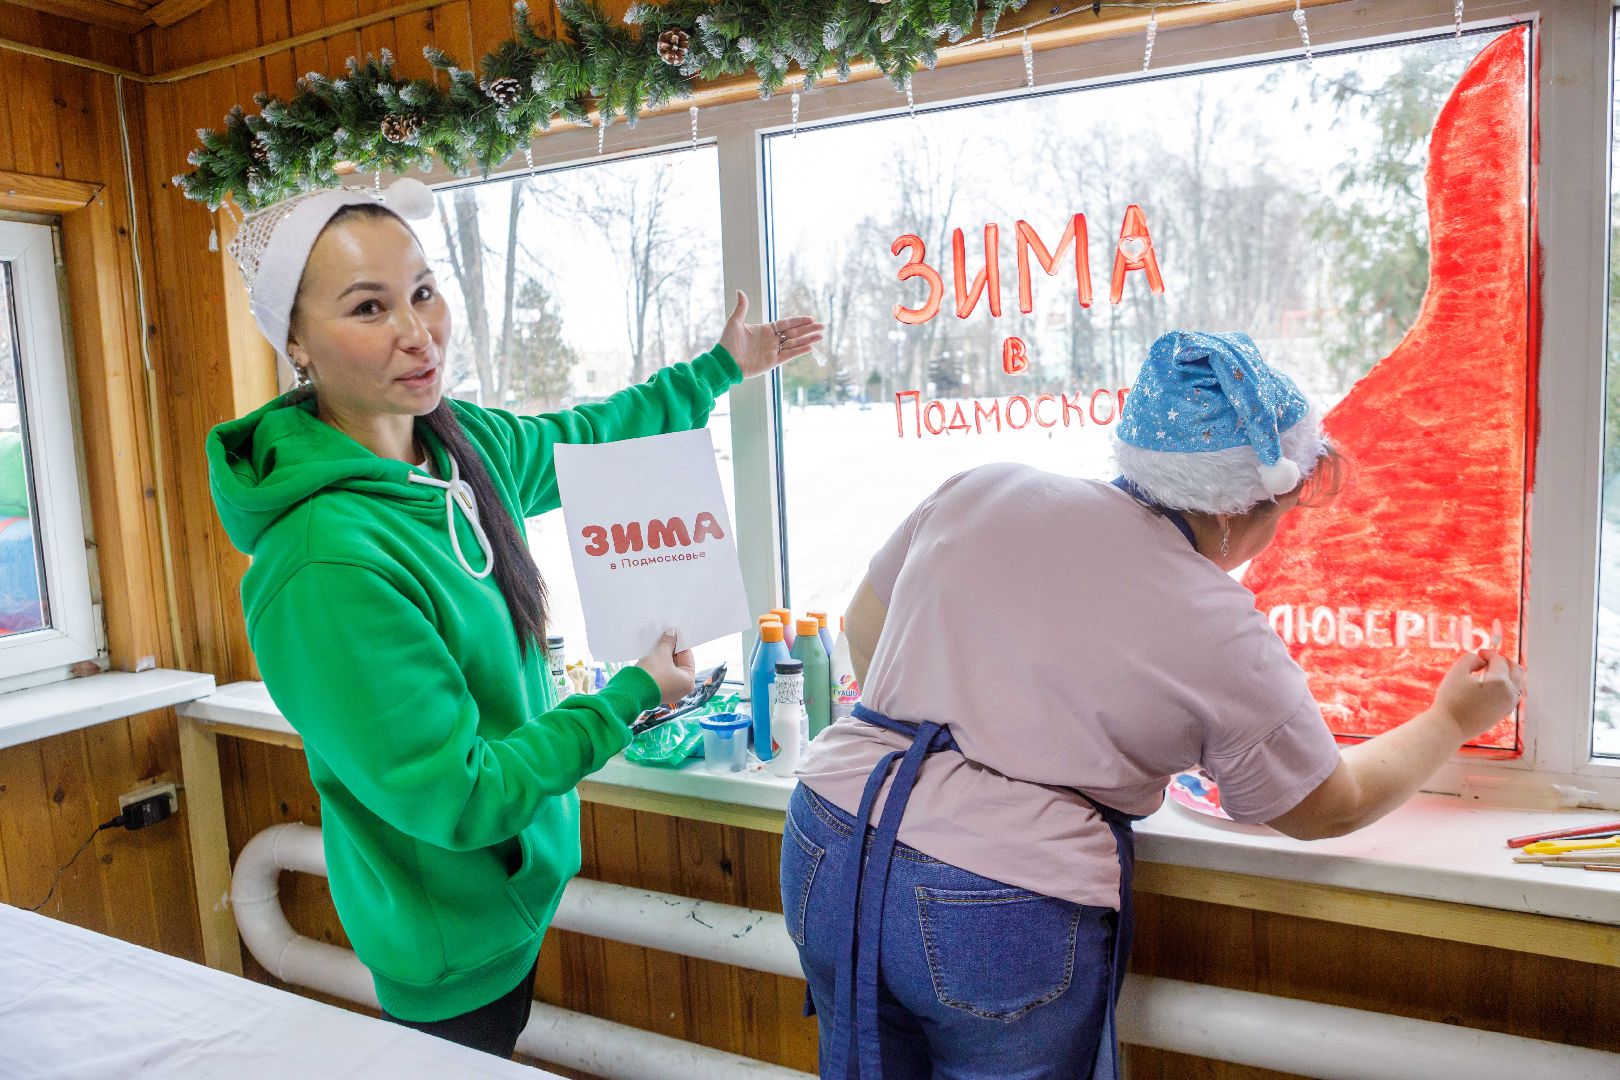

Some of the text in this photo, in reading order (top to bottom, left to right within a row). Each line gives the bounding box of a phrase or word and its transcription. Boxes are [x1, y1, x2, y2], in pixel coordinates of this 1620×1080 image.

[891, 203, 1165, 325] ЗИМА
[581, 511, 725, 556] ЗИМА
[621, 551, 706, 568] Подмосковье
[1268, 603, 1502, 652] ЛЮБЕРЦЫ
[833, 689, 858, 697] ГУАШЬ
